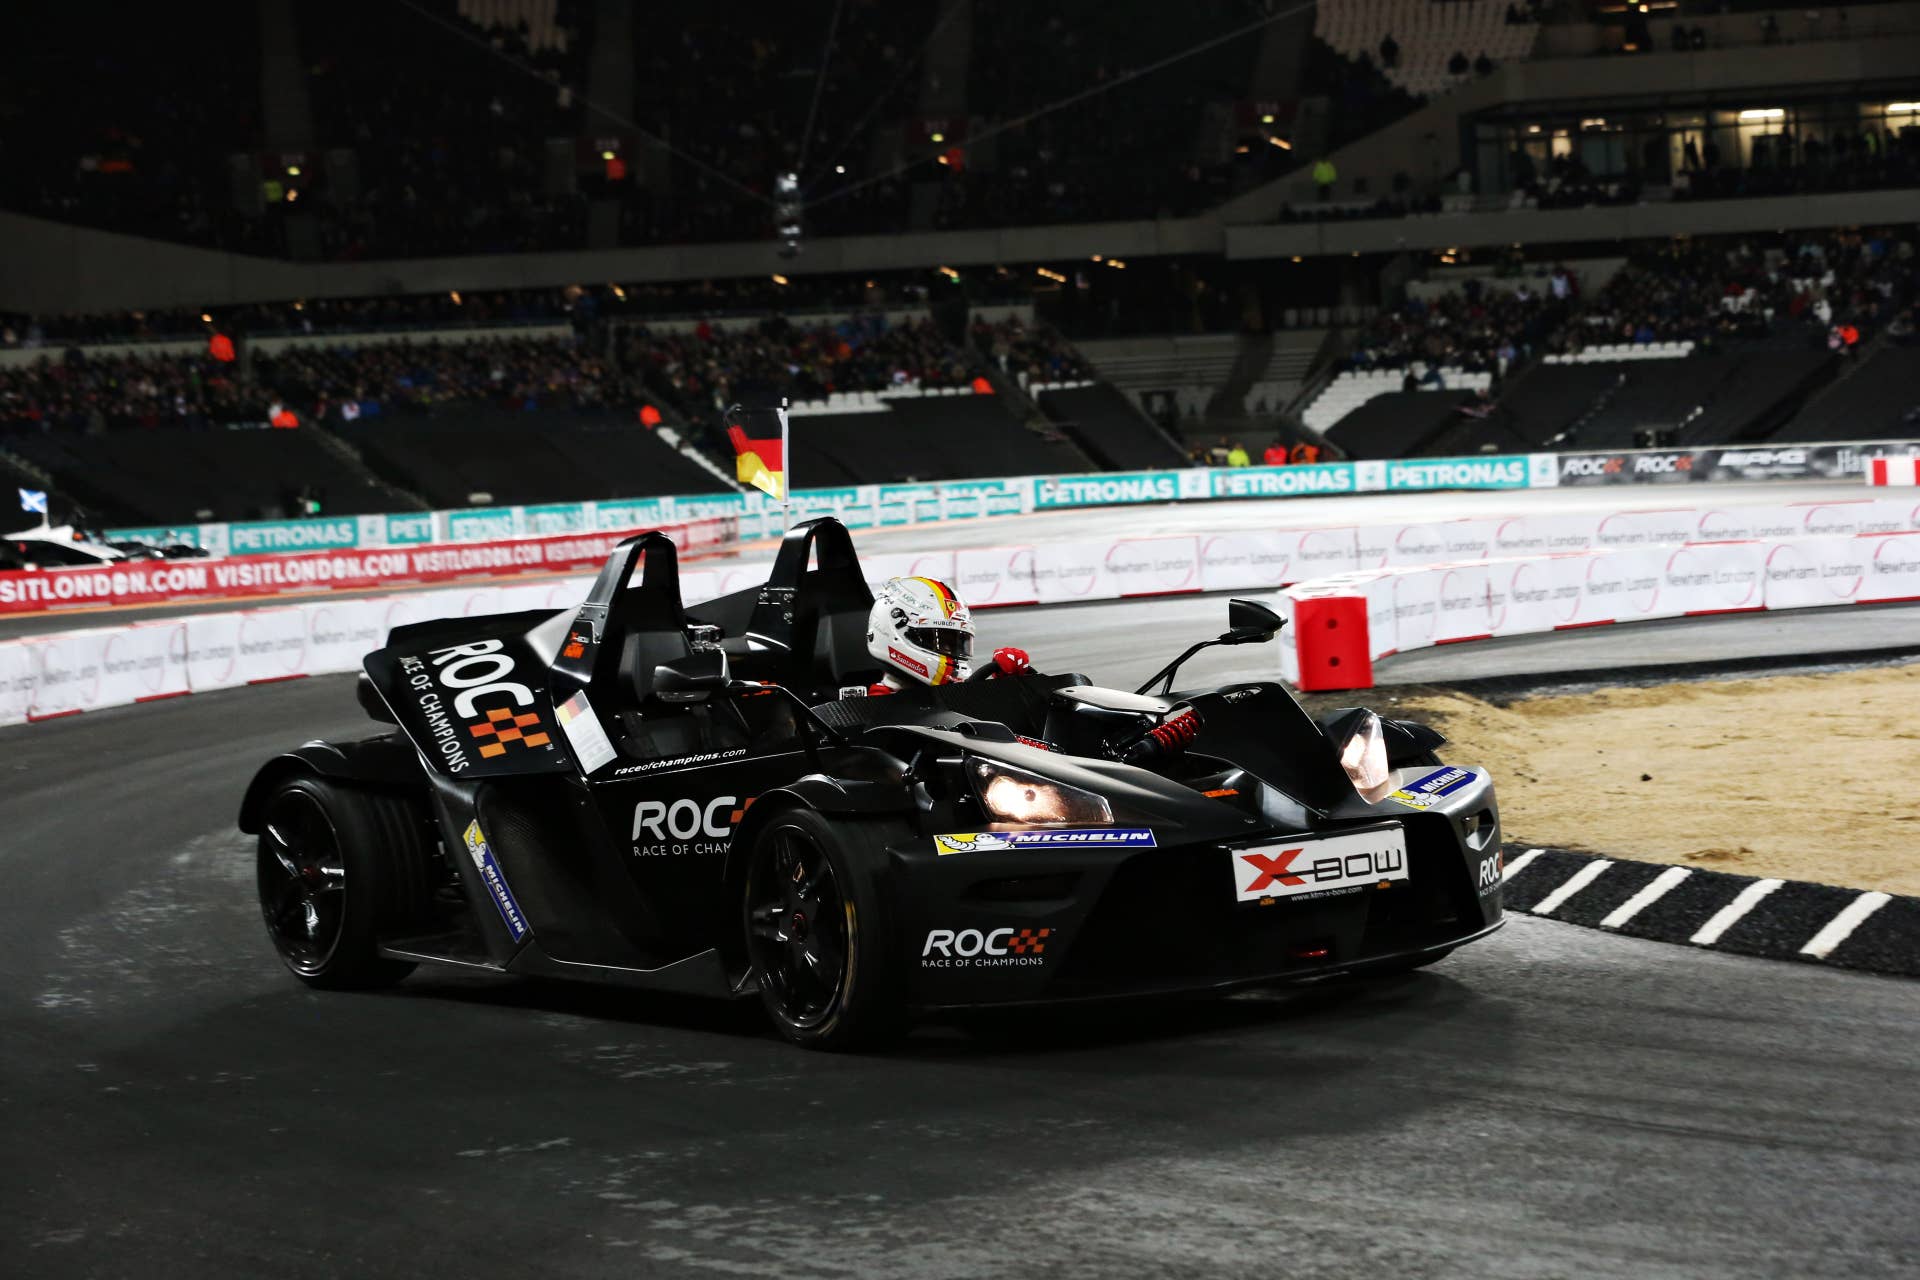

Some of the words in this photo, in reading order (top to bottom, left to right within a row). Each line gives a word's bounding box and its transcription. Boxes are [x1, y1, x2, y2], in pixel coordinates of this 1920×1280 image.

[1390, 462, 1524, 487] PETRONAS
[1562, 458, 1608, 476] ROC
[1634, 455, 1679, 473] ROC
[1039, 479, 1175, 503] PETRONAS
[1213, 468, 1350, 494] PETRONAS
[232, 523, 353, 549] PETRONAS
[214, 552, 408, 588] VISITLONDON.COM
[1873, 560, 1920, 575] Newha
[896, 653, 926, 675] Santander
[410, 674, 433, 691] OF
[427, 639, 535, 719] ROC
[419, 693, 470, 773] CHAMPIONS
[614, 748, 747, 776] raceofchampions.com
[1420, 768, 1469, 792] MICHELIN
[632, 796, 736, 841] ROC
[1014, 832, 1150, 842] MICHELIN
[633, 845, 667, 857] RACE
[672, 844, 690, 855] OF
[1240, 848, 1402, 892] X-BOW
[1479, 852, 1499, 887] ROC
[486, 864, 524, 933] MICHELIN
[922, 927, 1014, 957] ROC
[922, 959, 951, 968] RACE
[955, 958, 970, 967] OF
[975, 957, 1044, 967] CHAMPIONS
